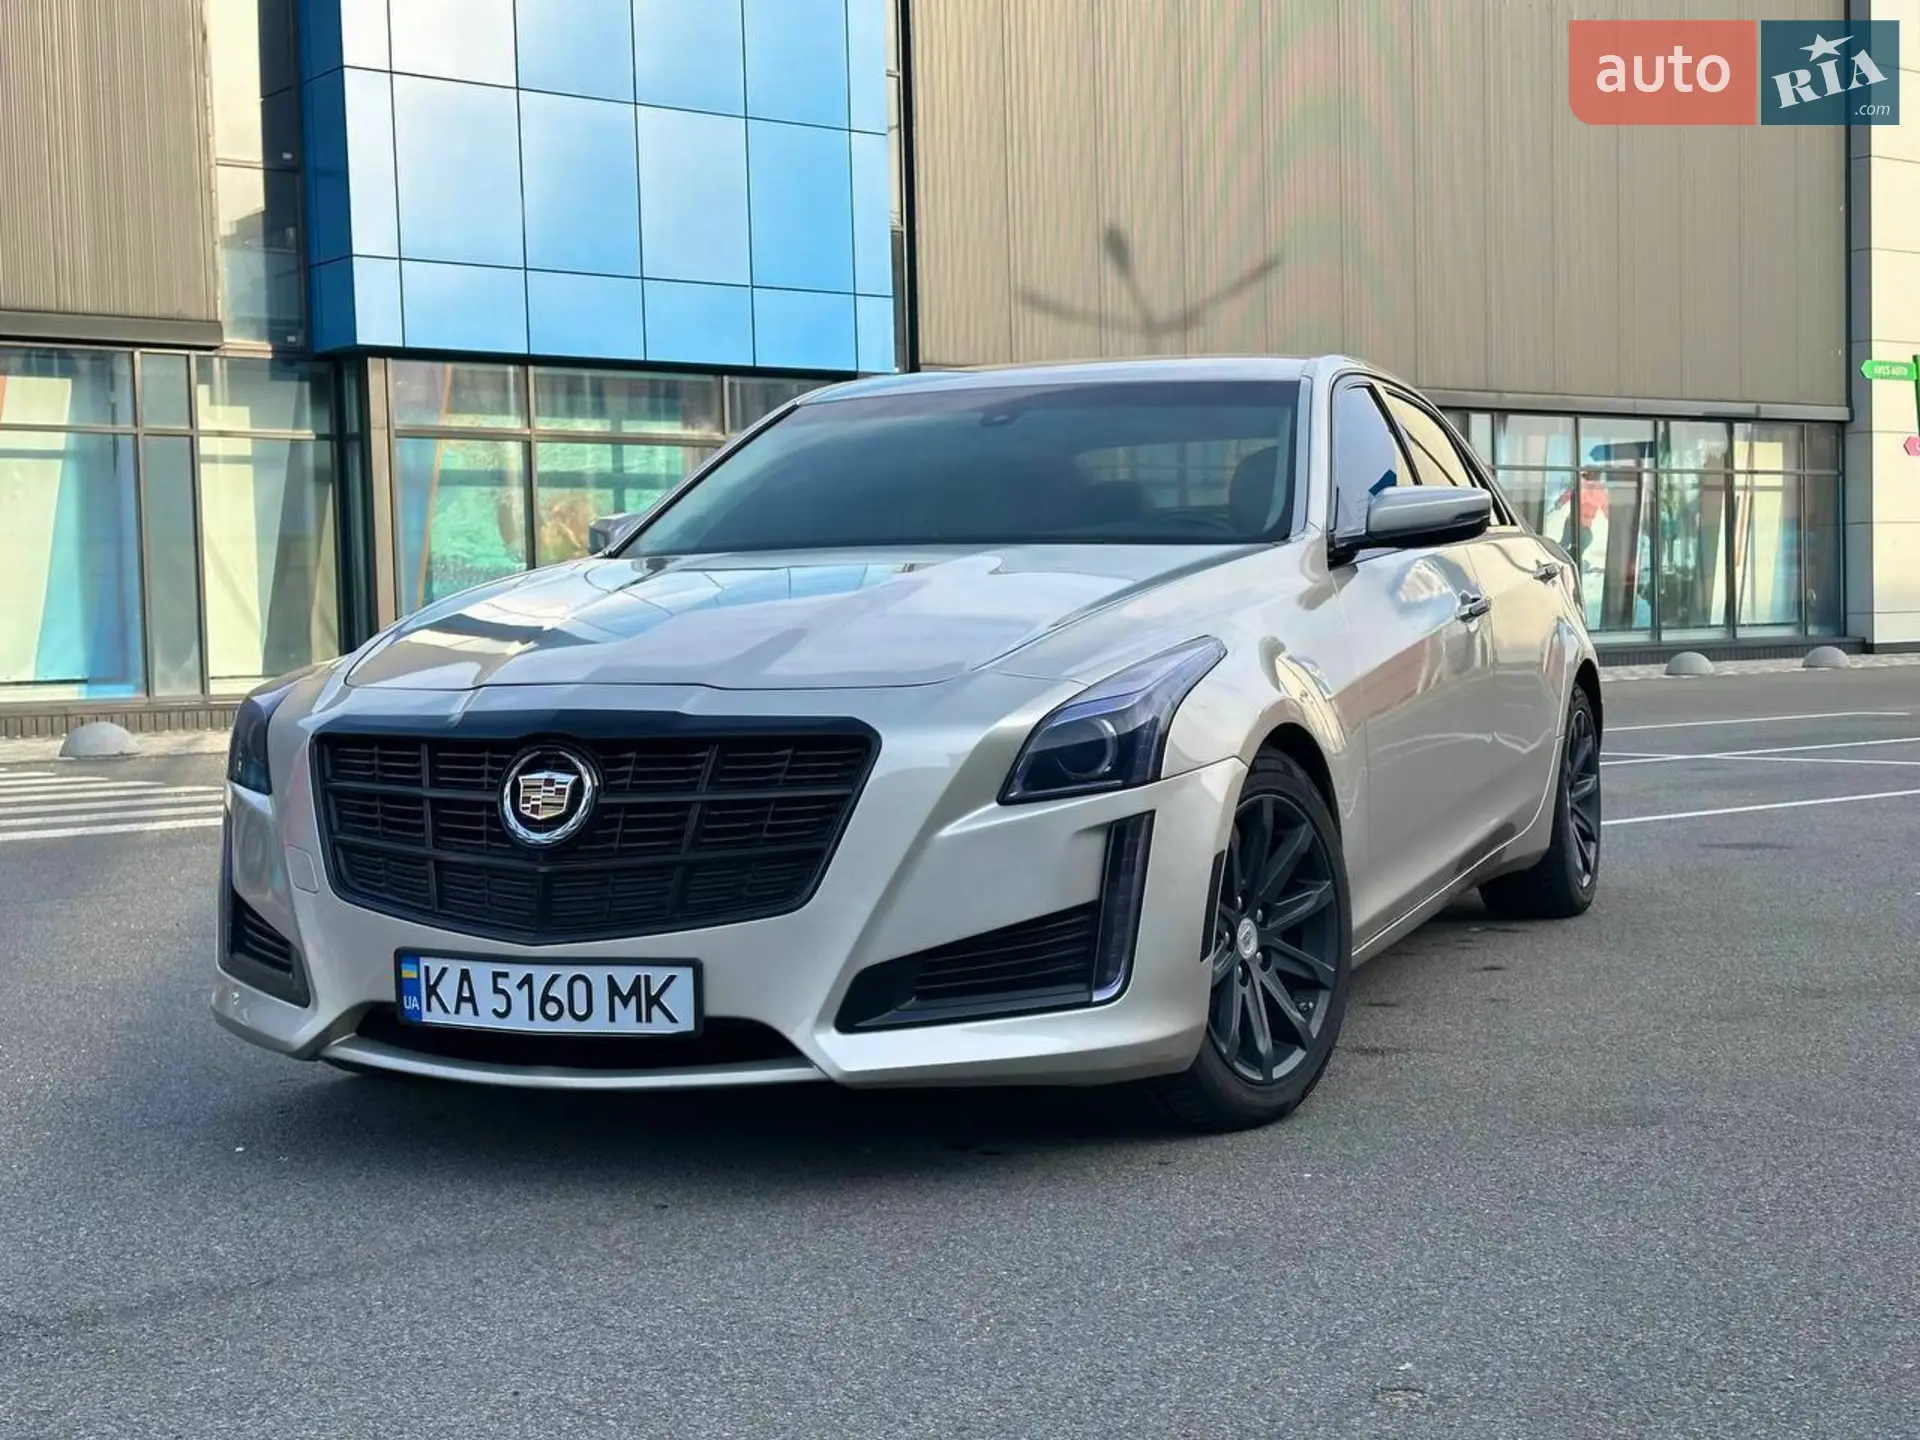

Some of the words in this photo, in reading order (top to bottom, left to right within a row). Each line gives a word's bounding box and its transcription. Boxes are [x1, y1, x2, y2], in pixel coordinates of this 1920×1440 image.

[403, 995, 420, 1011] UA
[423, 965, 479, 1017] KA
[491, 970, 594, 1022] 5160
[606, 973, 679, 1024] MK
